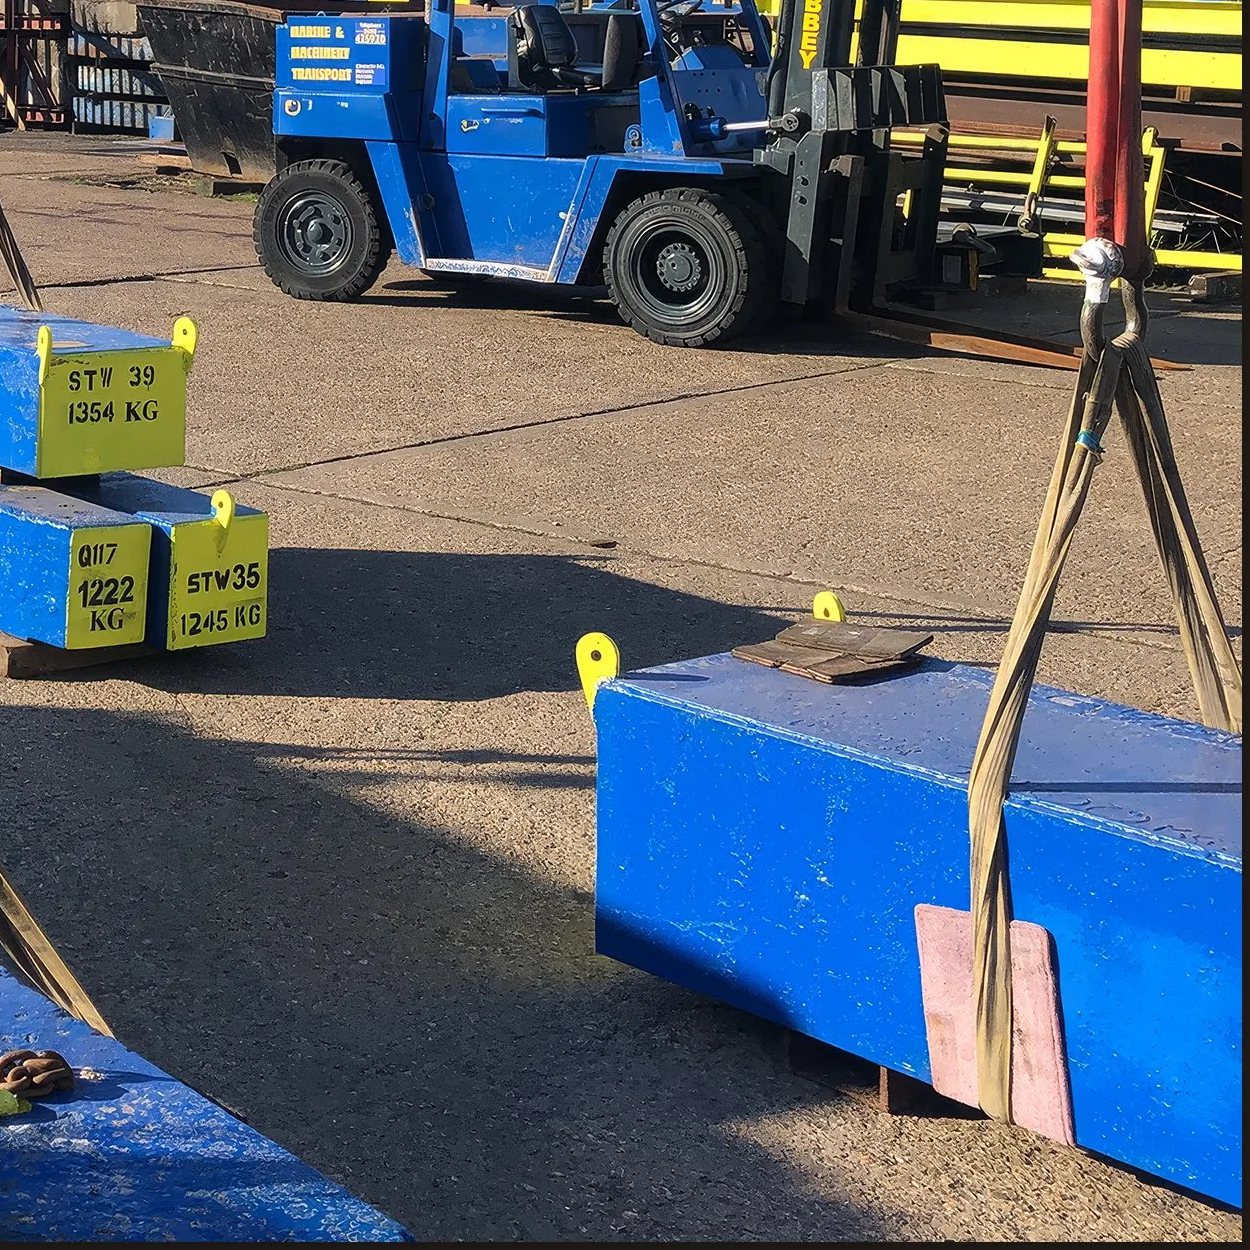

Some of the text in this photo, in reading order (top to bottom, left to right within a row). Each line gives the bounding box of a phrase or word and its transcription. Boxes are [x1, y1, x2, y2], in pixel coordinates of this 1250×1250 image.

[290, 25, 345, 39] MARINE &
[290, 46, 350, 60] MACHINERY
[291, 67, 352, 82] TRANSPORT
[67, 365, 156, 392] STW 39
[67, 400, 159, 425] 1354 KG
[77, 543, 118, 569] Q117
[77, 575, 135, 608] 1222
[89, 607, 125, 632] KG
[180, 602, 261, 637] 1245 KG
